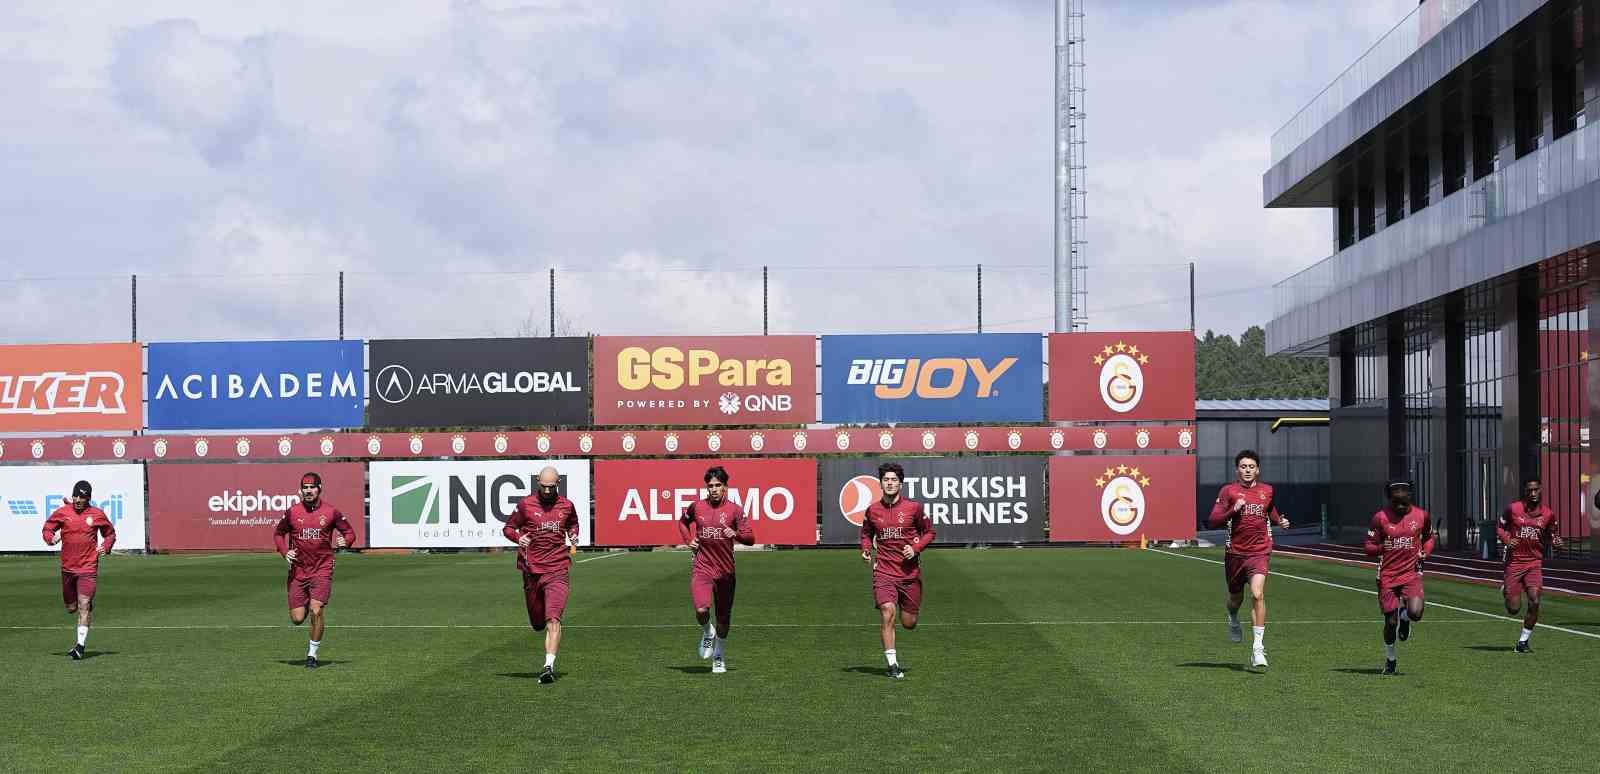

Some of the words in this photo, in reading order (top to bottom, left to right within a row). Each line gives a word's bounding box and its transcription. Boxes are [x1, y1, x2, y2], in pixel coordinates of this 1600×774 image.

[0, 371, 127, 415] LKER
[155, 370, 357, 400] ACIBADEM
[617, 400, 685, 408] POWERED
[693, 400, 710, 408] BY
[744, 394, 792, 411] QNB
[449, 474, 568, 524] NG
[904, 476, 1027, 499] TURKISH
[208, 490, 301, 516] ekiphan
[924, 501, 1029, 525] IRLINES
[418, 528, 450, 538] lead
[460, 528, 483, 538] the
